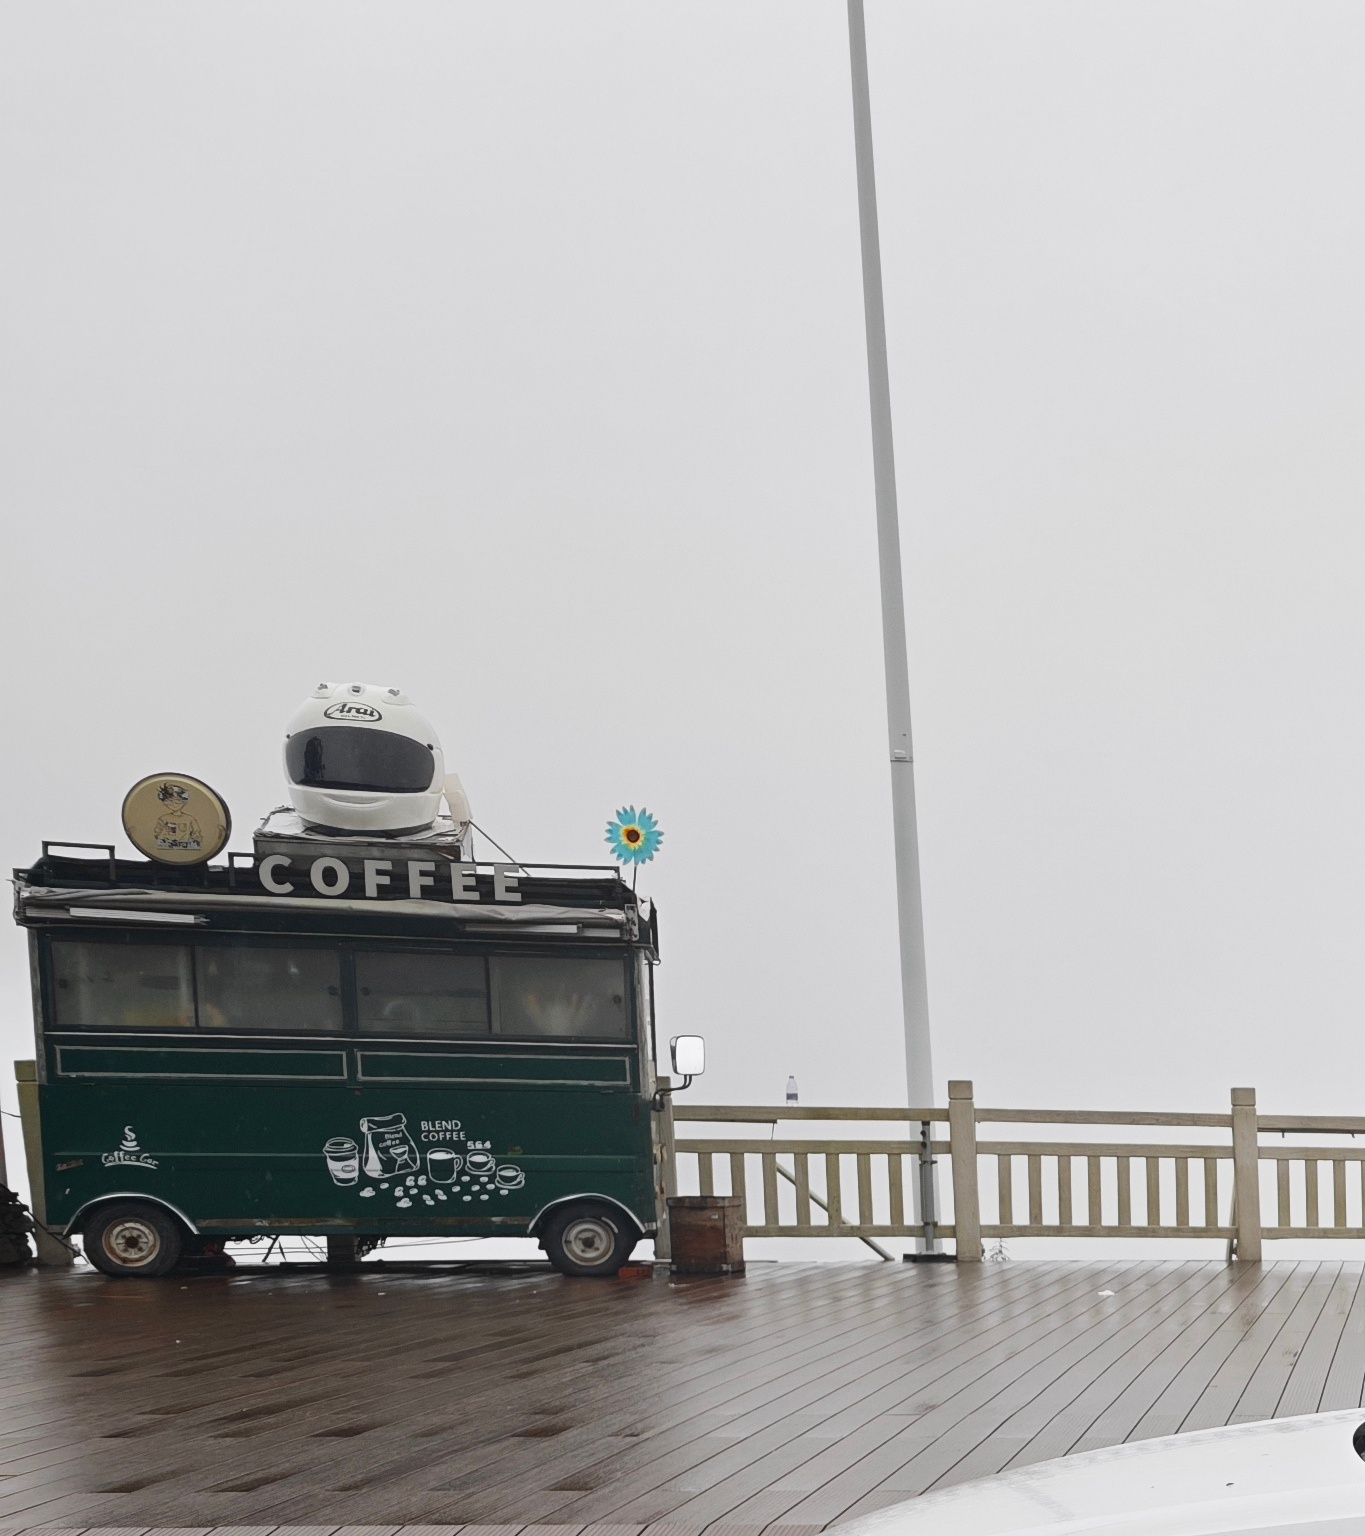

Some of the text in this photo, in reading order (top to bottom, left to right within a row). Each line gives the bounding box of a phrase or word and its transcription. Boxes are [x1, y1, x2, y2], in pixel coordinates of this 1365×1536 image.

[327, 703, 376, 717] Arai
[258, 854, 522, 902] COFFEE
[421, 1120, 461, 1131] BLEND
[421, 1131, 466, 1141] COFFEE
[101, 1151, 137, 1164] Coffee
